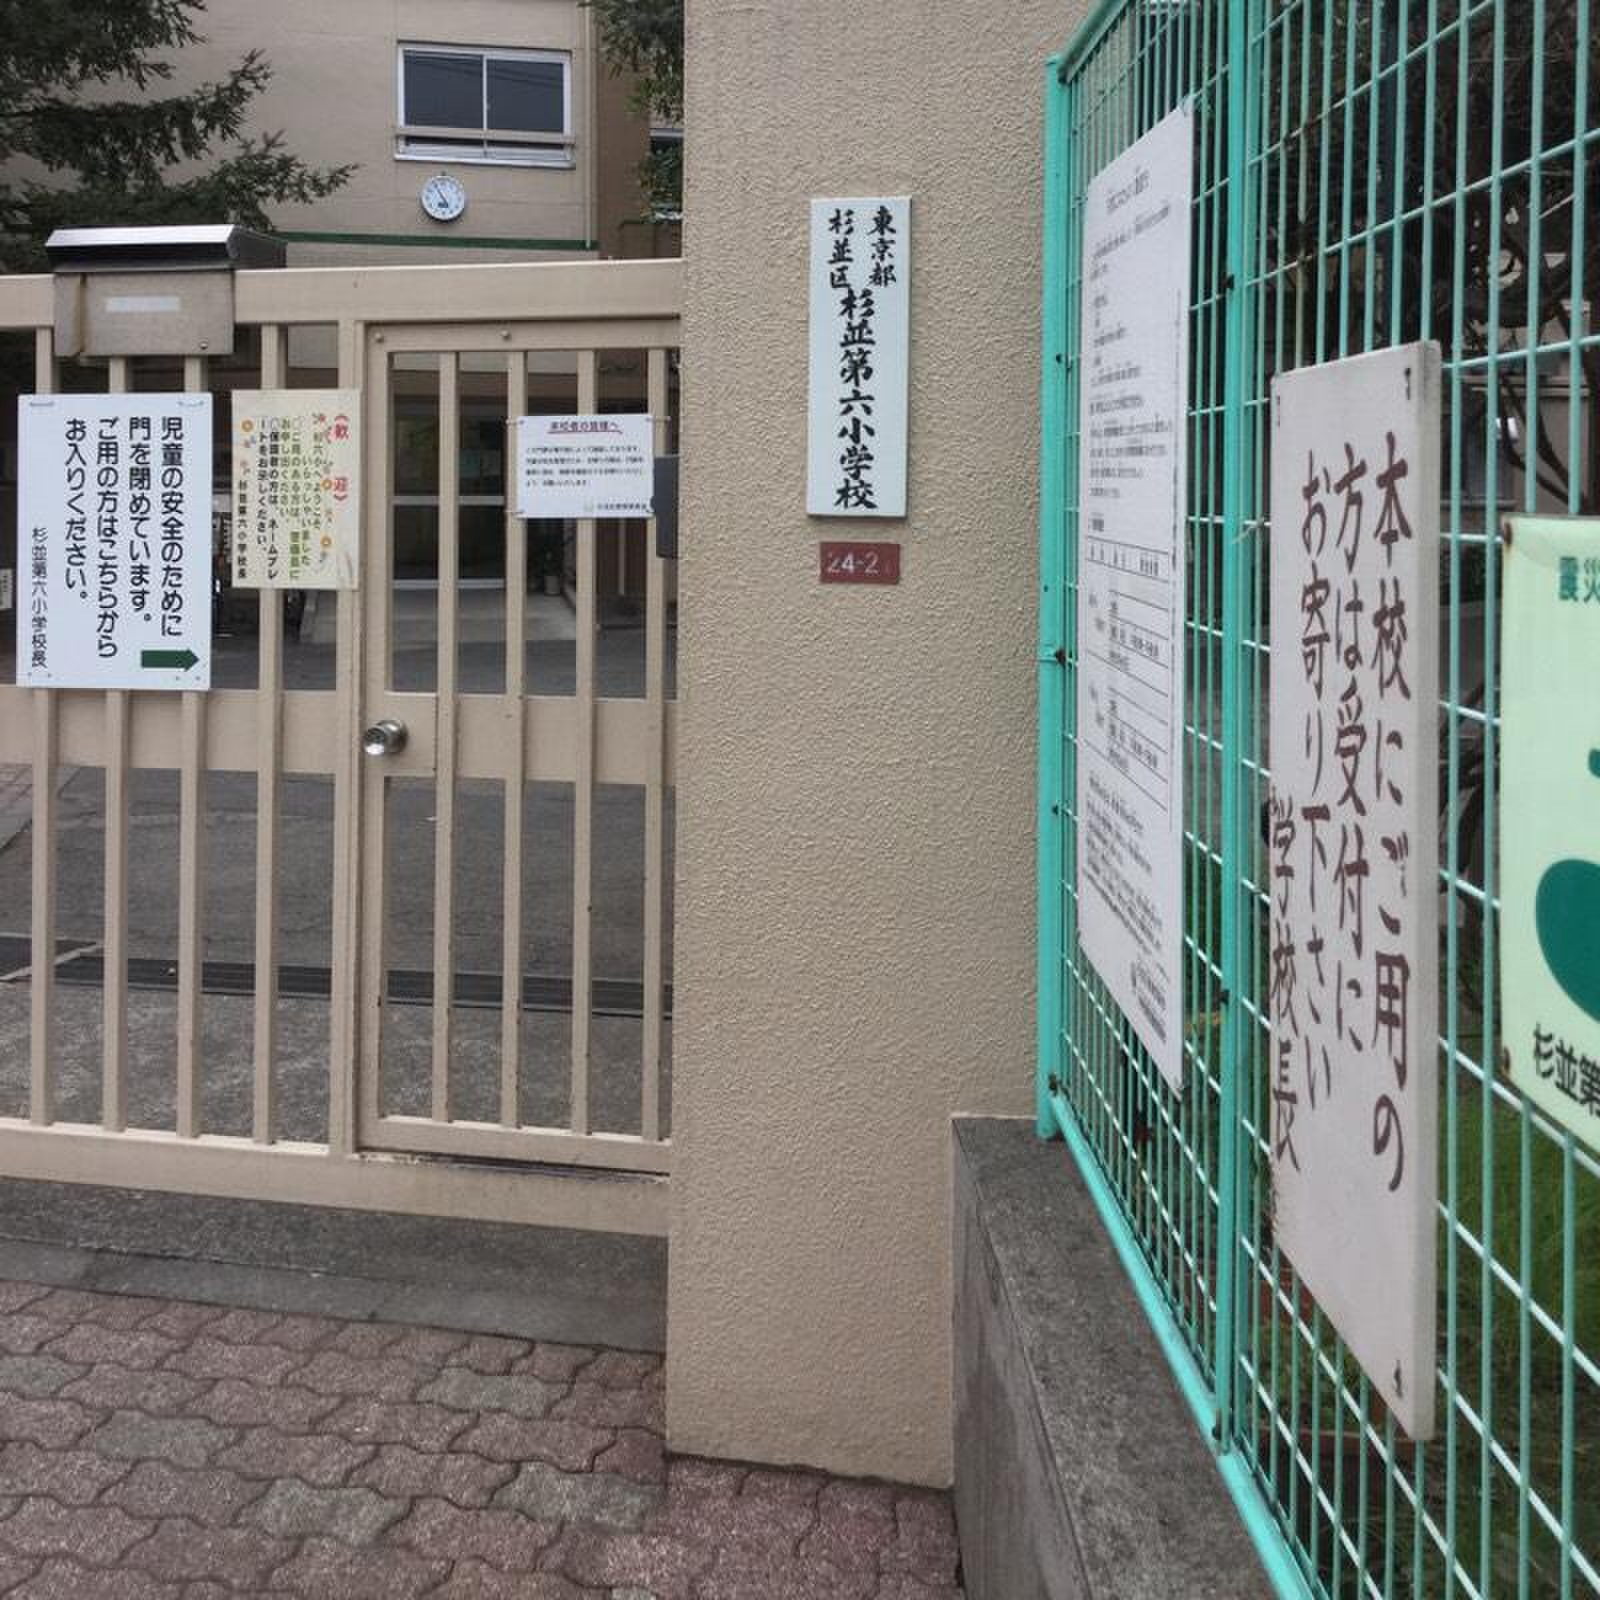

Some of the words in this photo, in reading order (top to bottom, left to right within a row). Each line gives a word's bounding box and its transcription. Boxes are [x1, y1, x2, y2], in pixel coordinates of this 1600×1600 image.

[828, 208, 855, 289] 杉並区
[868, 205, 897, 288] 東京都
[65, 417, 87, 600] お入りください。
[834, 289, 879, 509] 杉並第六小学校
[31, 527, 48, 669] 杉並第六小学校長
[97, 416, 119, 659] ご用の方はこちらから
[129, 416, 152, 622] 門を閉めています。
[161, 416, 184, 637] 児童の安全のために
[1301, 448, 1331, 1110] お寄り下さい
[1334, 442, 1370, 1052] 方は受付に
[1371, 431, 1412, 1191] 本校にご用の
[1271, 786, 1300, 1171] 学校長
